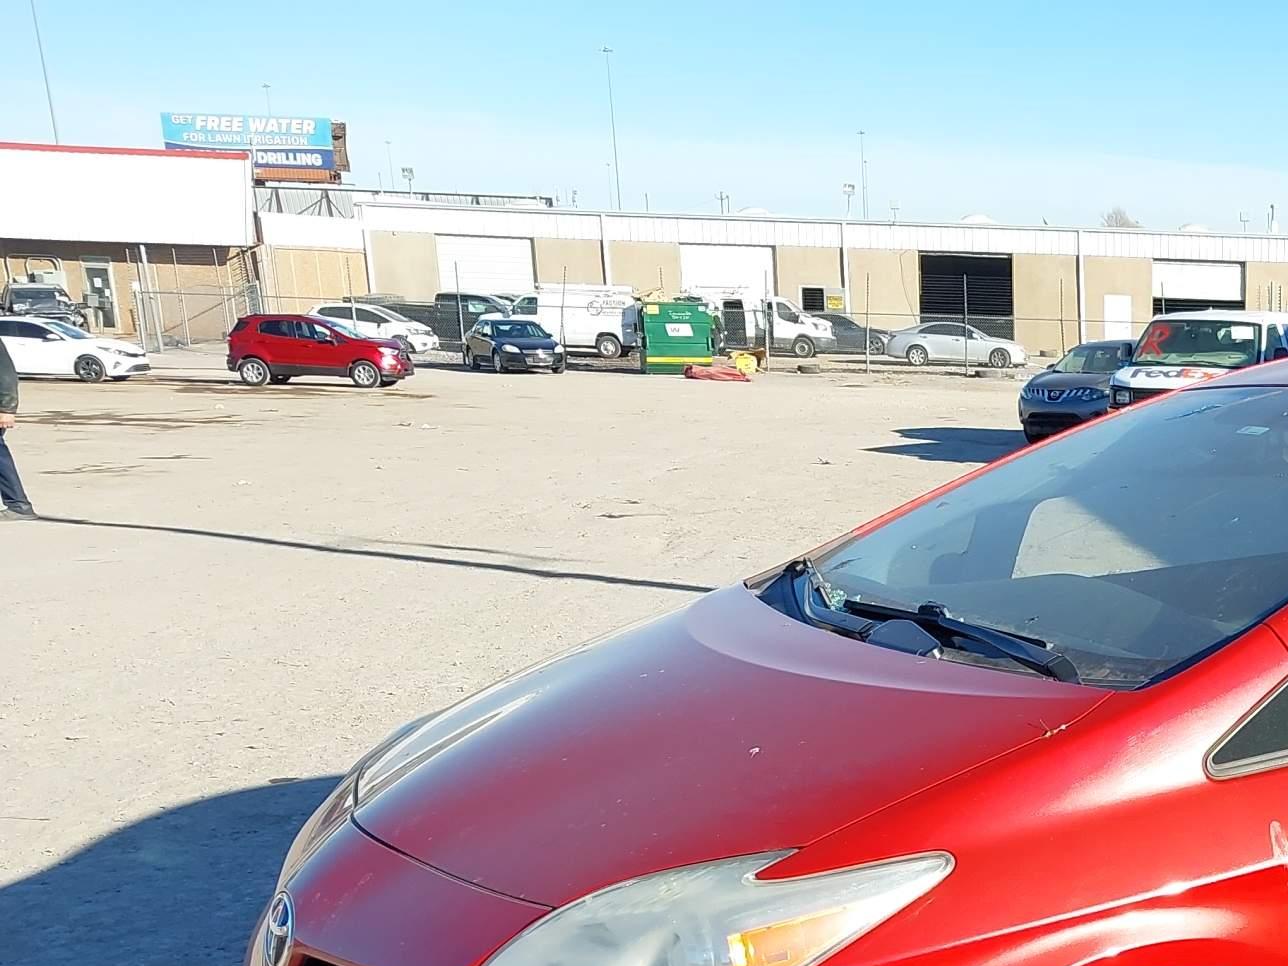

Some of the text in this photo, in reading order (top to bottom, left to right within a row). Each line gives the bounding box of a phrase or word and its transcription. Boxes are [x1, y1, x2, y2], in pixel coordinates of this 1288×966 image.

[171, 115, 316, 135] GET FREE WATER
[183, 133, 206, 142] FOR
[208, 133, 241, 143] LAWN
[257, 152, 323, 166] DRILLING
[1142, 325, 1171, 357] R
[1130, 368, 1219, 380] FedEx
